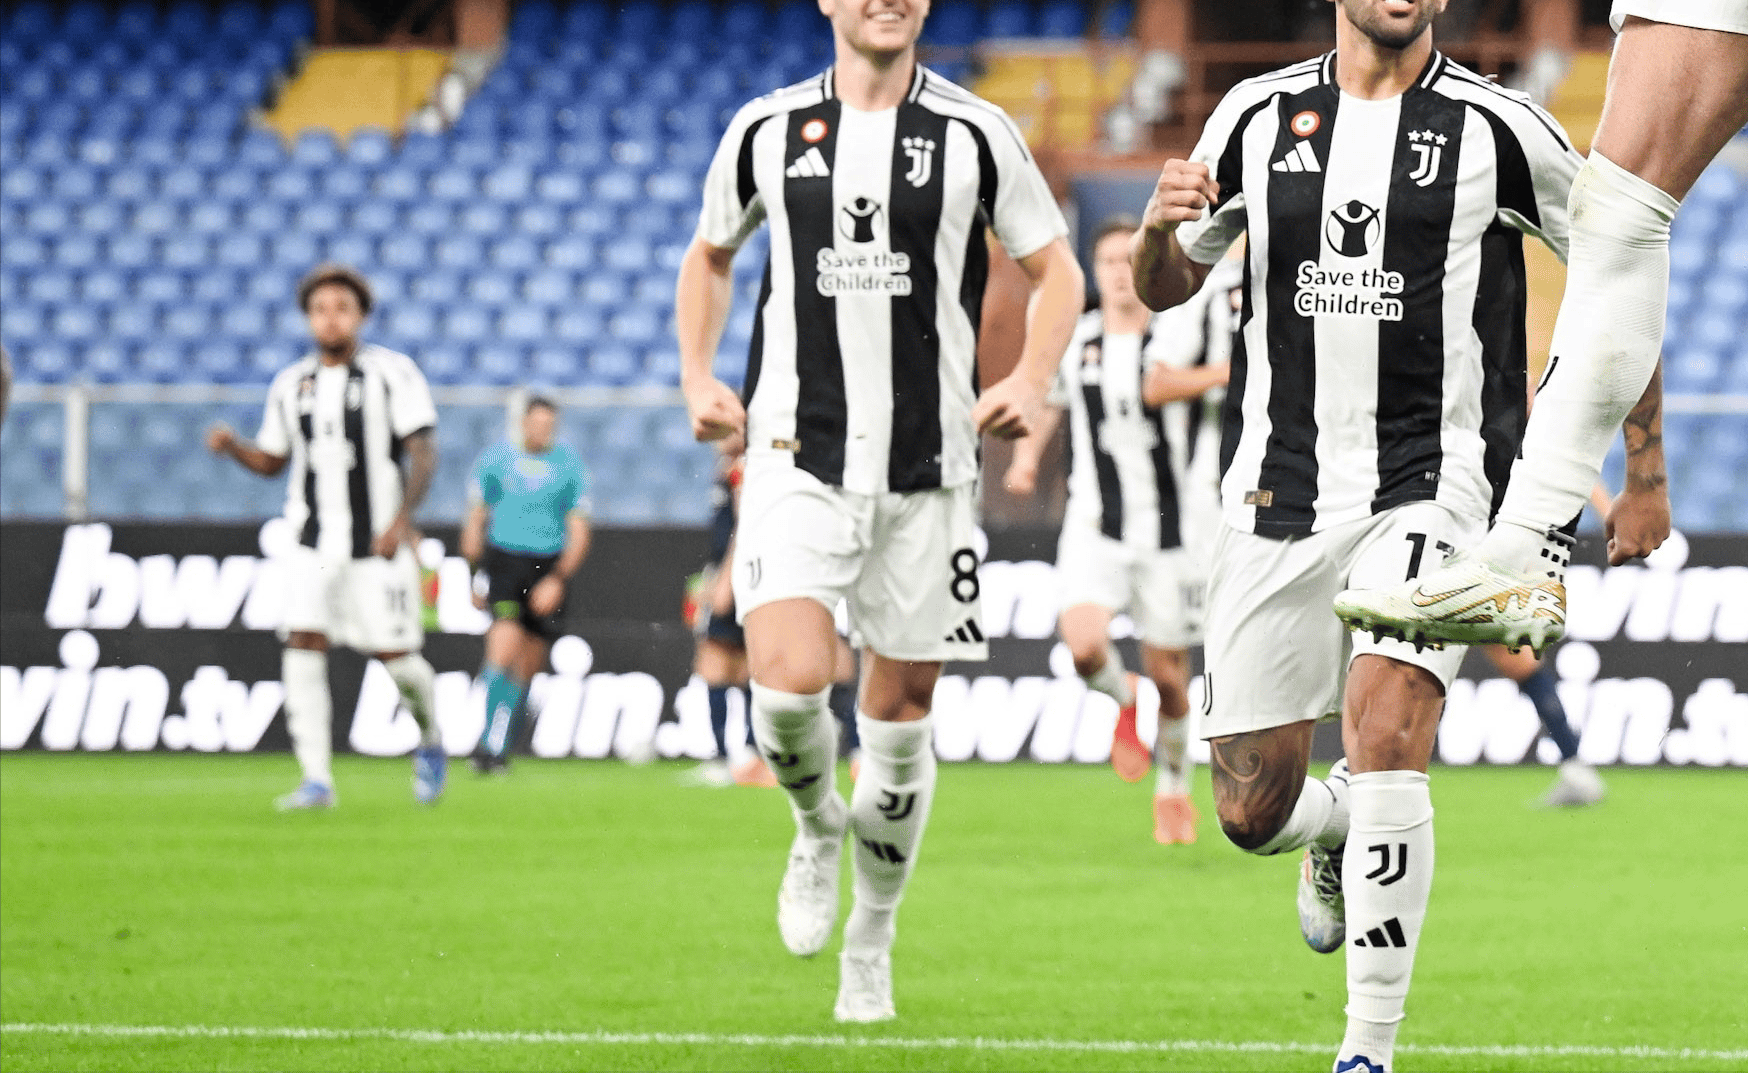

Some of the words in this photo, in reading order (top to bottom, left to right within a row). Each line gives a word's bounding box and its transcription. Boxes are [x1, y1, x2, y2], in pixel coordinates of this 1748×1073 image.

[821, 253, 868, 268] Save
[873, 252, 906, 269] the
[821, 272, 909, 292] Children
[1300, 264, 1354, 286] Save
[1361, 268, 1401, 290] the
[1298, 291, 1400, 317] Children
[951, 548, 980, 603] 8
